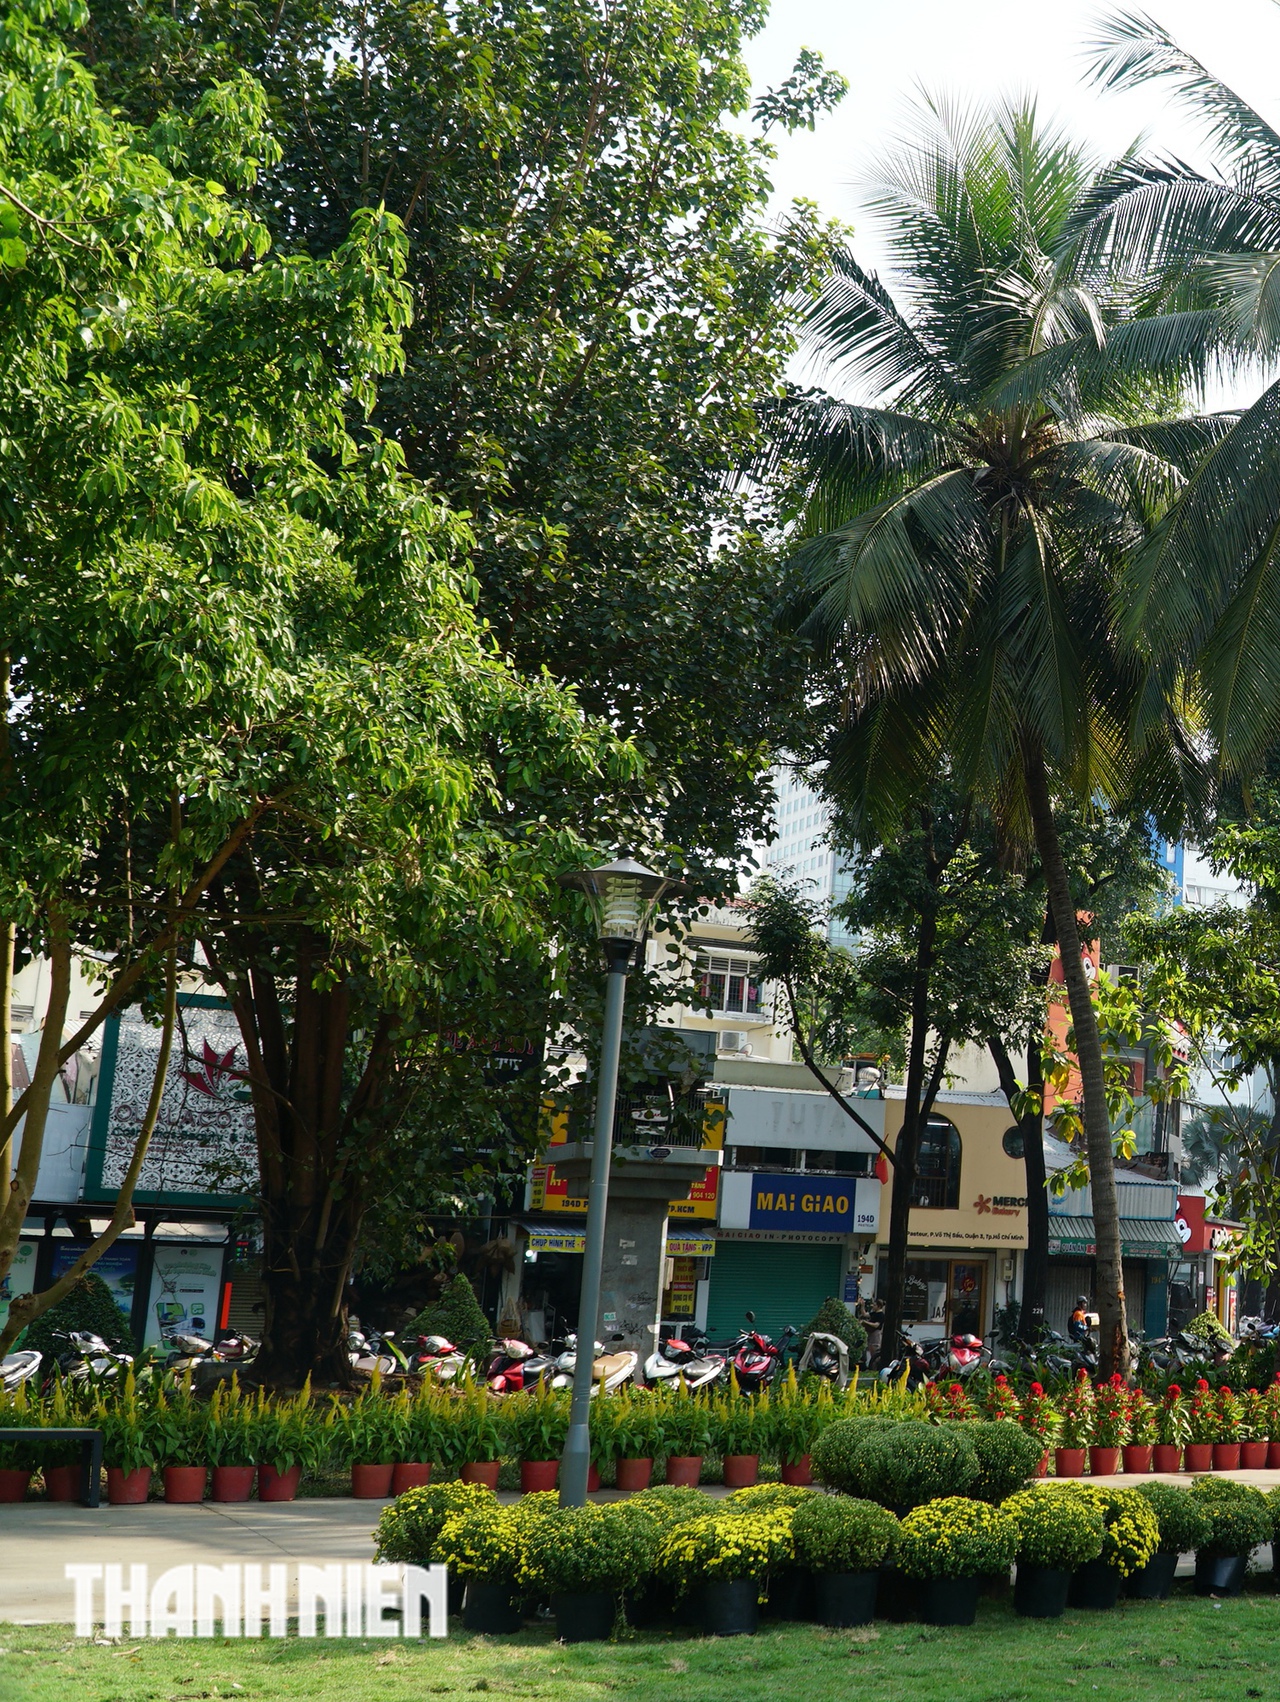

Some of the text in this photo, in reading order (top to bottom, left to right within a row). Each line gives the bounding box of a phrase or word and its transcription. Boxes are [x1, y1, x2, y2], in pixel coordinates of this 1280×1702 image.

[692, 1191, 715, 1200] 904 120
[561, 1199, 581, 1208] 194D
[857, 1214, 875, 1223] 194D
[701, 1244, 713, 1252] VPP
